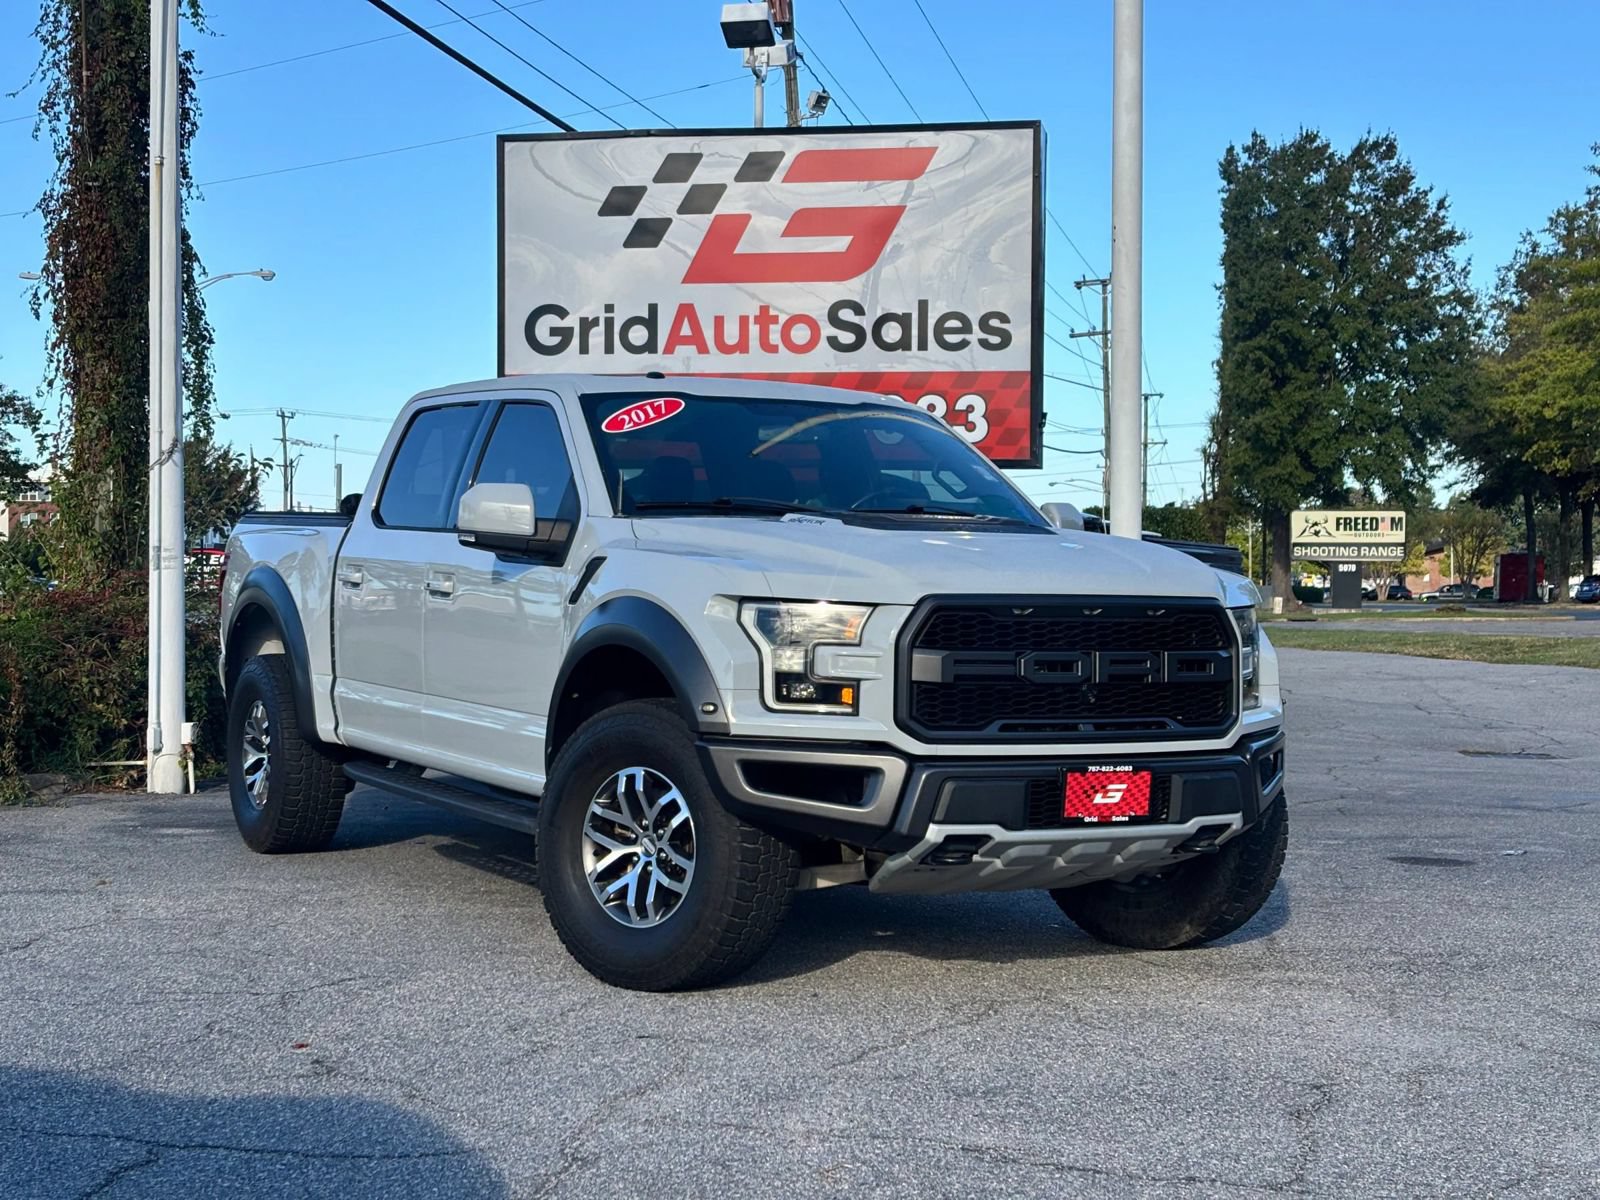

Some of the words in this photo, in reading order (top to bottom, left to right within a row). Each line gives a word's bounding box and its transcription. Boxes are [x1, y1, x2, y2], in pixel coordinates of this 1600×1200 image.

[618, 400, 666, 430] 2017
[885, 394, 989, 444] 83
[1336, 516, 1403, 532] FREEDM
[1293, 546, 1358, 557] SHOOTING
[1360, 546, 1405, 557] RANGE
[941, 650, 1232, 683] FORD
